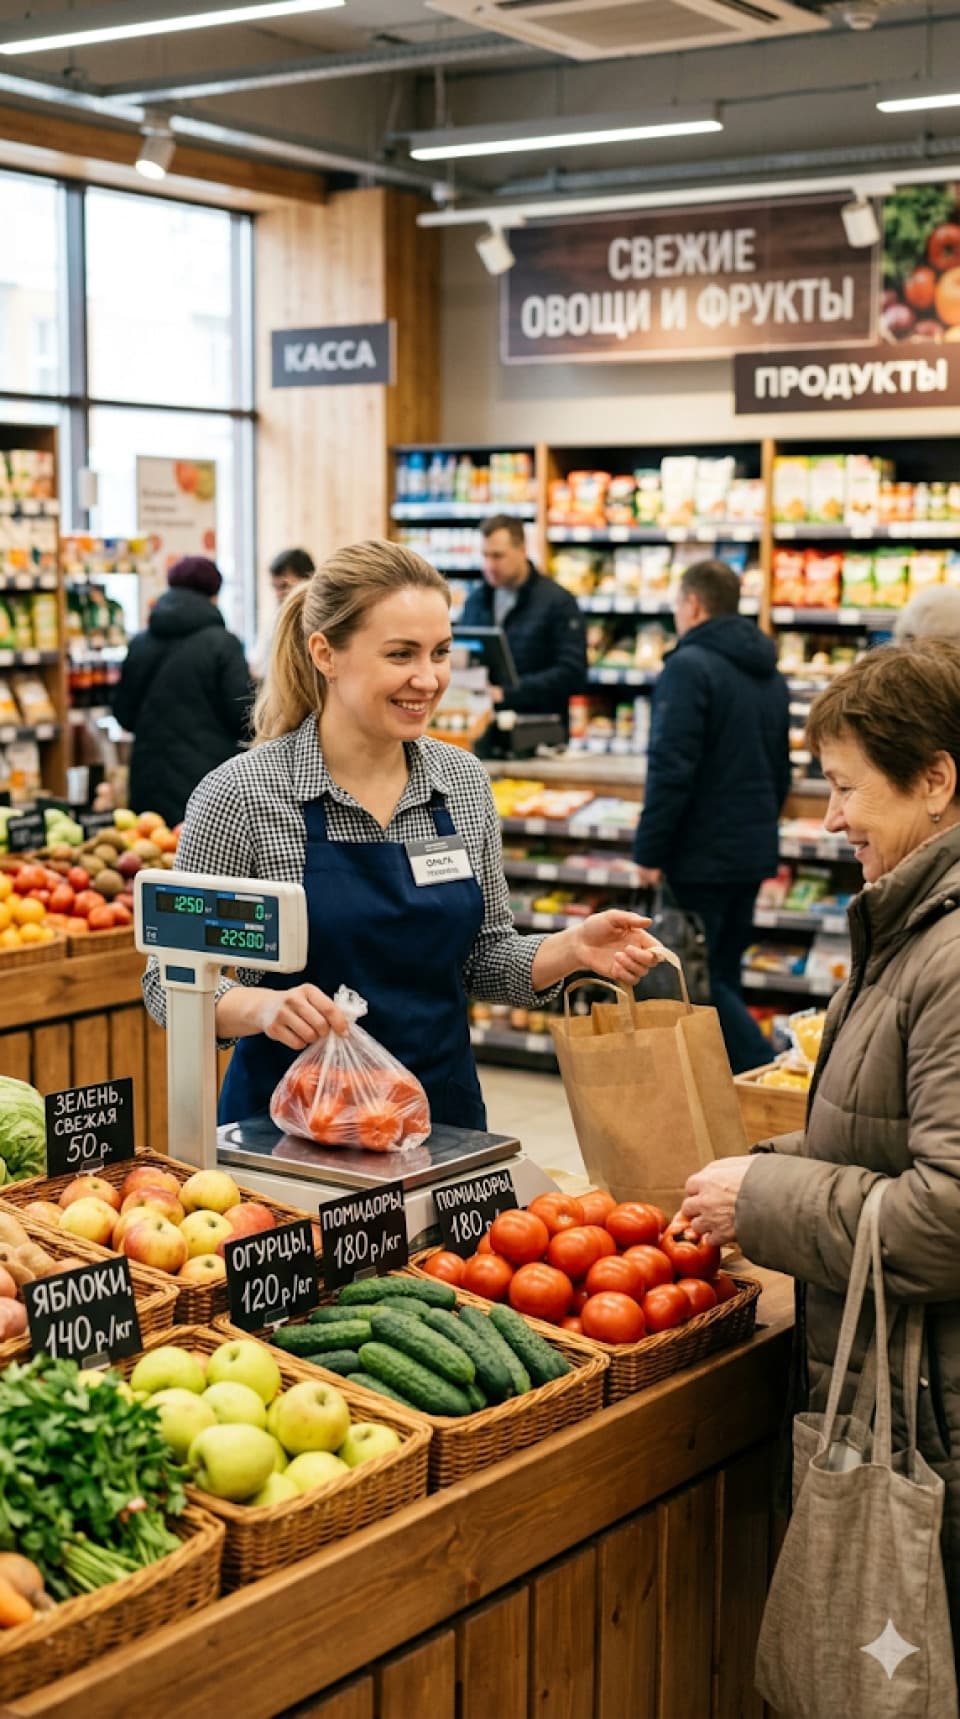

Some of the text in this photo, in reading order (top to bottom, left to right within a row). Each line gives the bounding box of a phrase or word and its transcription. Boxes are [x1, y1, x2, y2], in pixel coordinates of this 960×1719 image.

[608, 228, 756, 281] СВЕЖИЕ
[521, 276, 855, 339] ОВОЩИ И ФРУКТЫ
[284, 339, 376, 373] КАССА
[755, 358, 948, 401] ПРОДУКТЫ
[54, 1086, 123, 1115] ЗЕЛЕНЬ,
[54, 1108, 117, 1136] СВЕЖАЯ
[67, 1132, 97, 1162] 50
[450, 1209, 483, 1243] 180
[232, 1227, 311, 1271] ОГУРЦЫ,
[333, 1231, 368, 1269] 180
[32, 1265, 132, 1318] ЯБЛОКИ,
[241, 1273, 279, 1314] 120
[45, 1315, 92, 1360] 140
